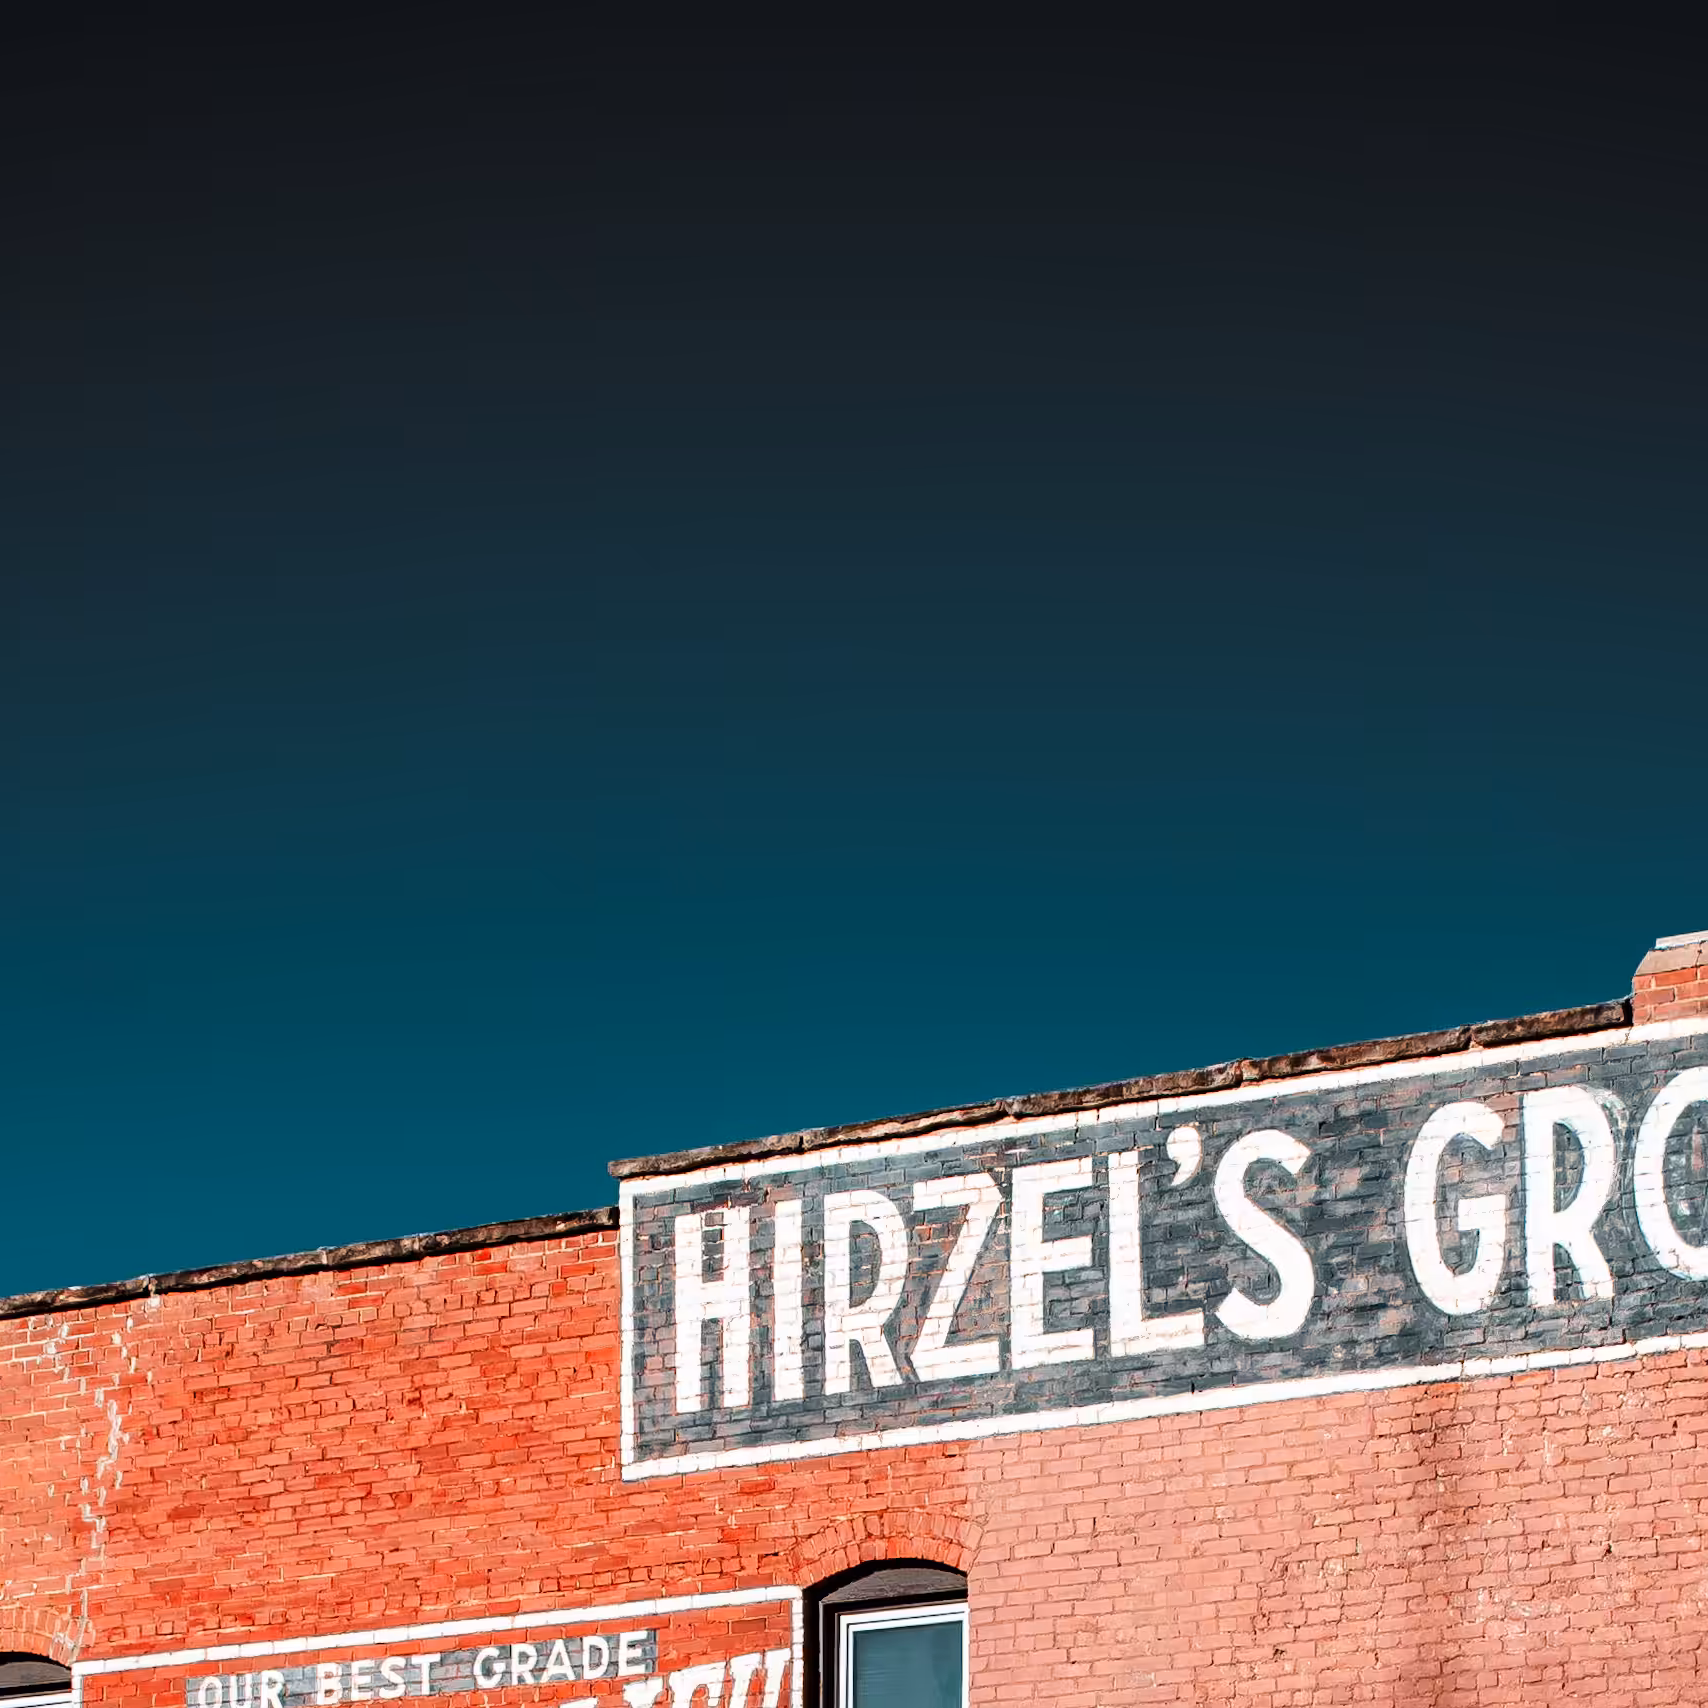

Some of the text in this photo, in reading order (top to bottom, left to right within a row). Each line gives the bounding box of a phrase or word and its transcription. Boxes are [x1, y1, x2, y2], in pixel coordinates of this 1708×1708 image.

[674, 1126, 1316, 1413] HIRZEL'S
[317, 1654, 441, 1705] BEST
[473, 1630, 649, 1690] GRADE
